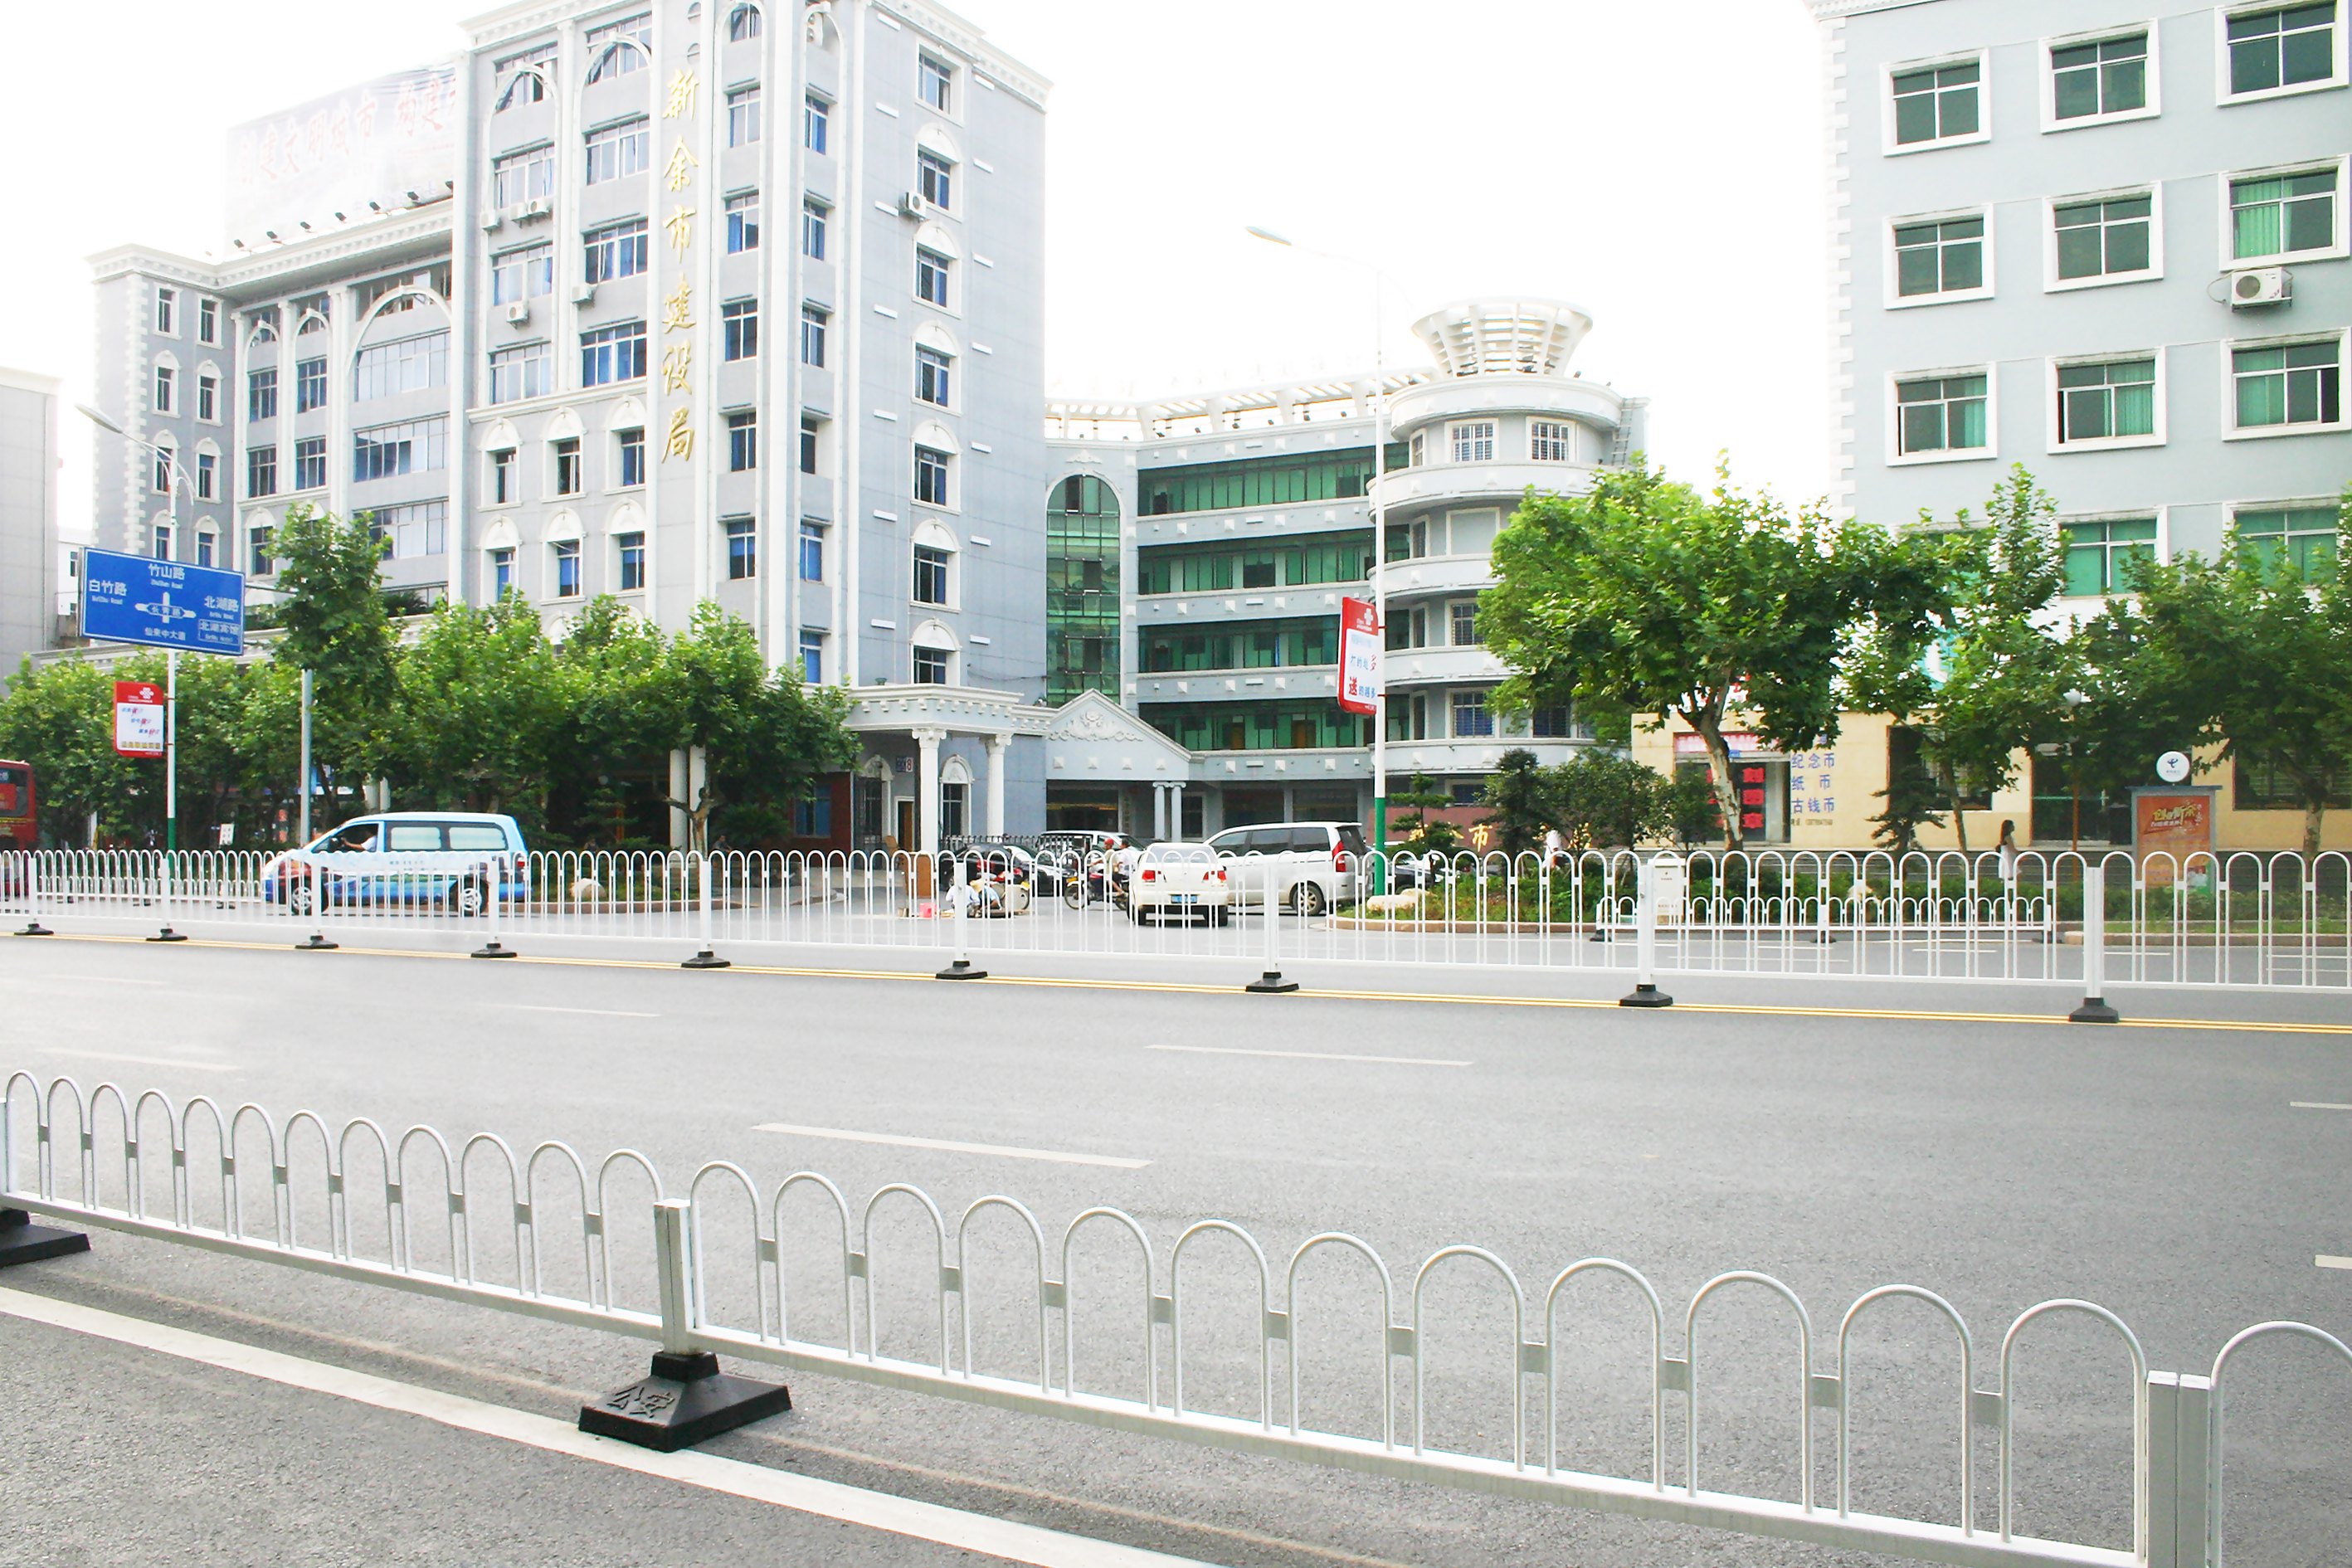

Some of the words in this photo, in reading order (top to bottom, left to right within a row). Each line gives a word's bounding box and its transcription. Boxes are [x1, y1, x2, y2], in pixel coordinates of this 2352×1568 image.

[661, 68, 701, 465] 新余市建设局
[148, 563, 186, 581] 竹山路
[88, 579, 128, 597] 白竹路
[203, 595, 239, 612] 北湖路
[1791, 752, 1835, 769] 纪念币
[1791, 796, 1835, 814] 古钱币
